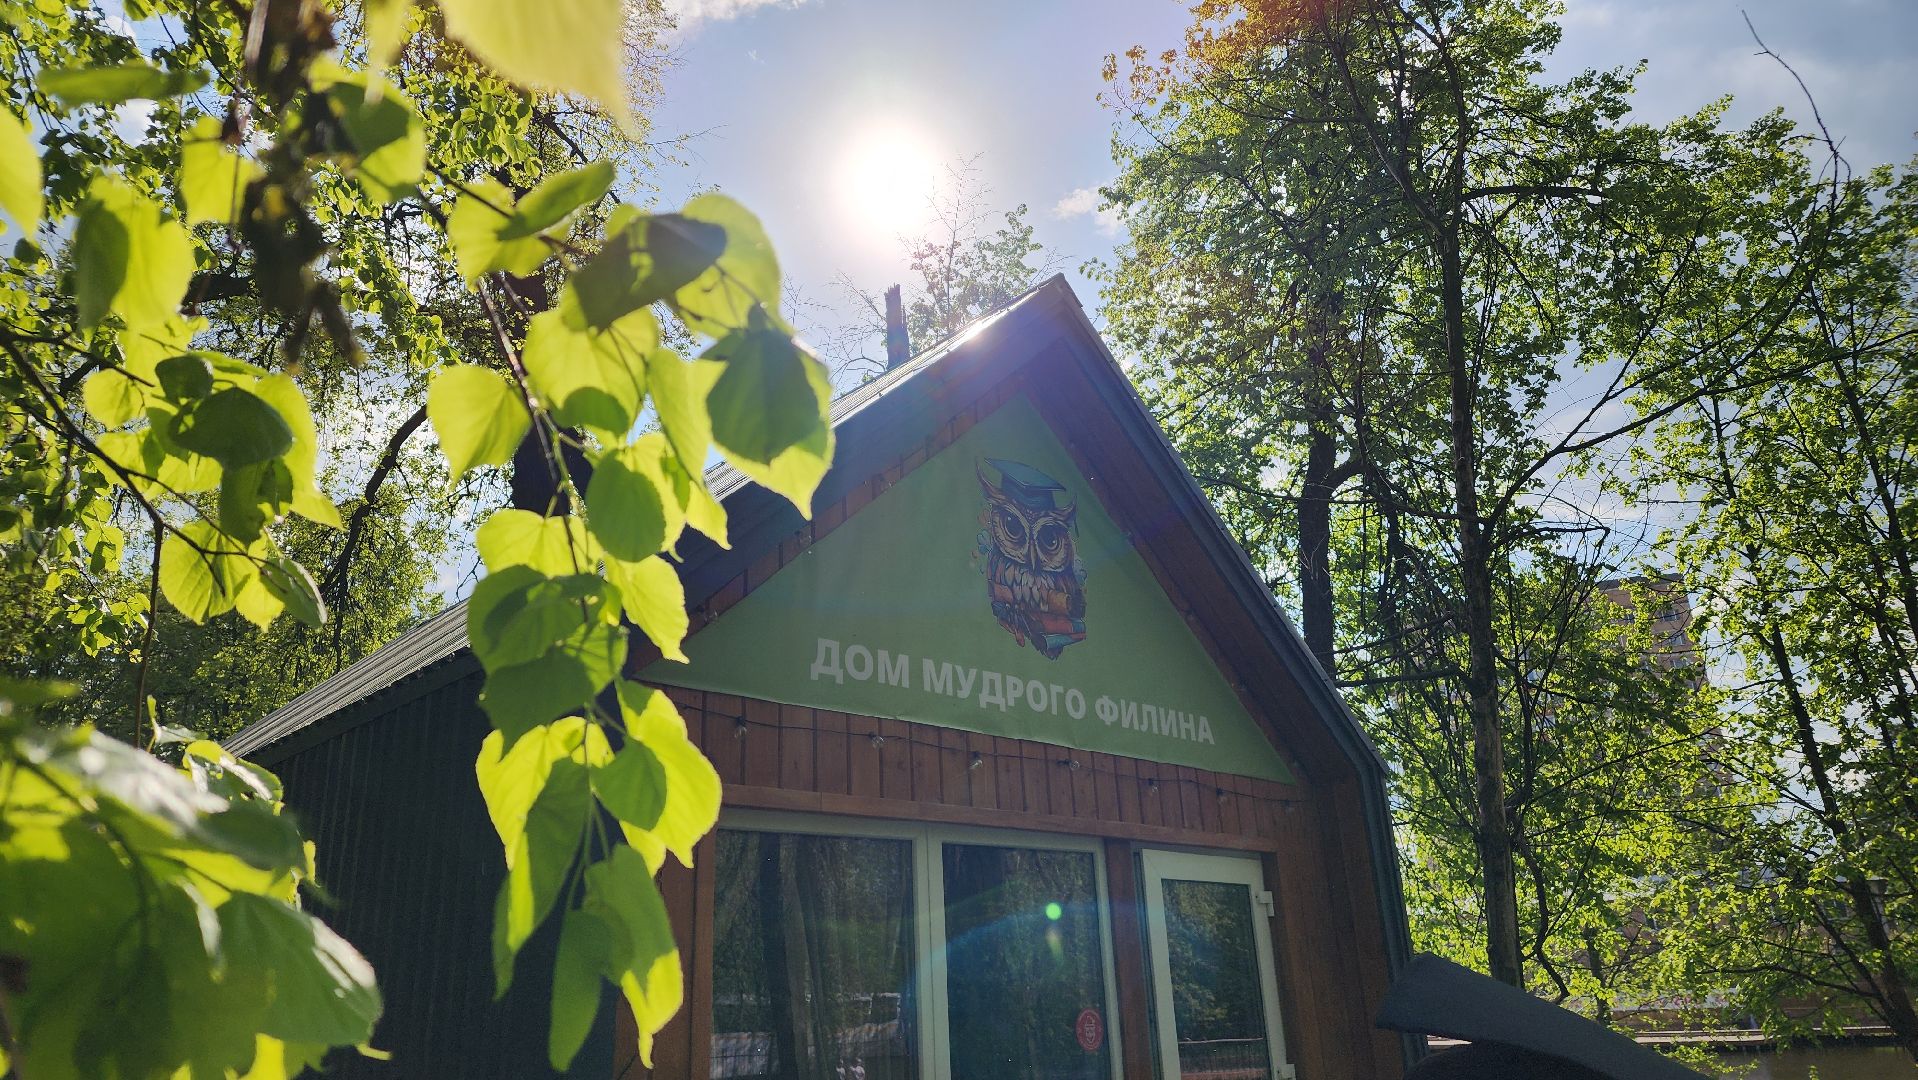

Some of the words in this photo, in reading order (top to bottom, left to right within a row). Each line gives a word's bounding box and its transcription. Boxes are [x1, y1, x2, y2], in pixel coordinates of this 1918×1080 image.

[810, 638, 910, 688] ДОМ
[922, 658, 1086, 720] МУДРОГО
[1094, 695, 1215, 745] ФИЛИНА
